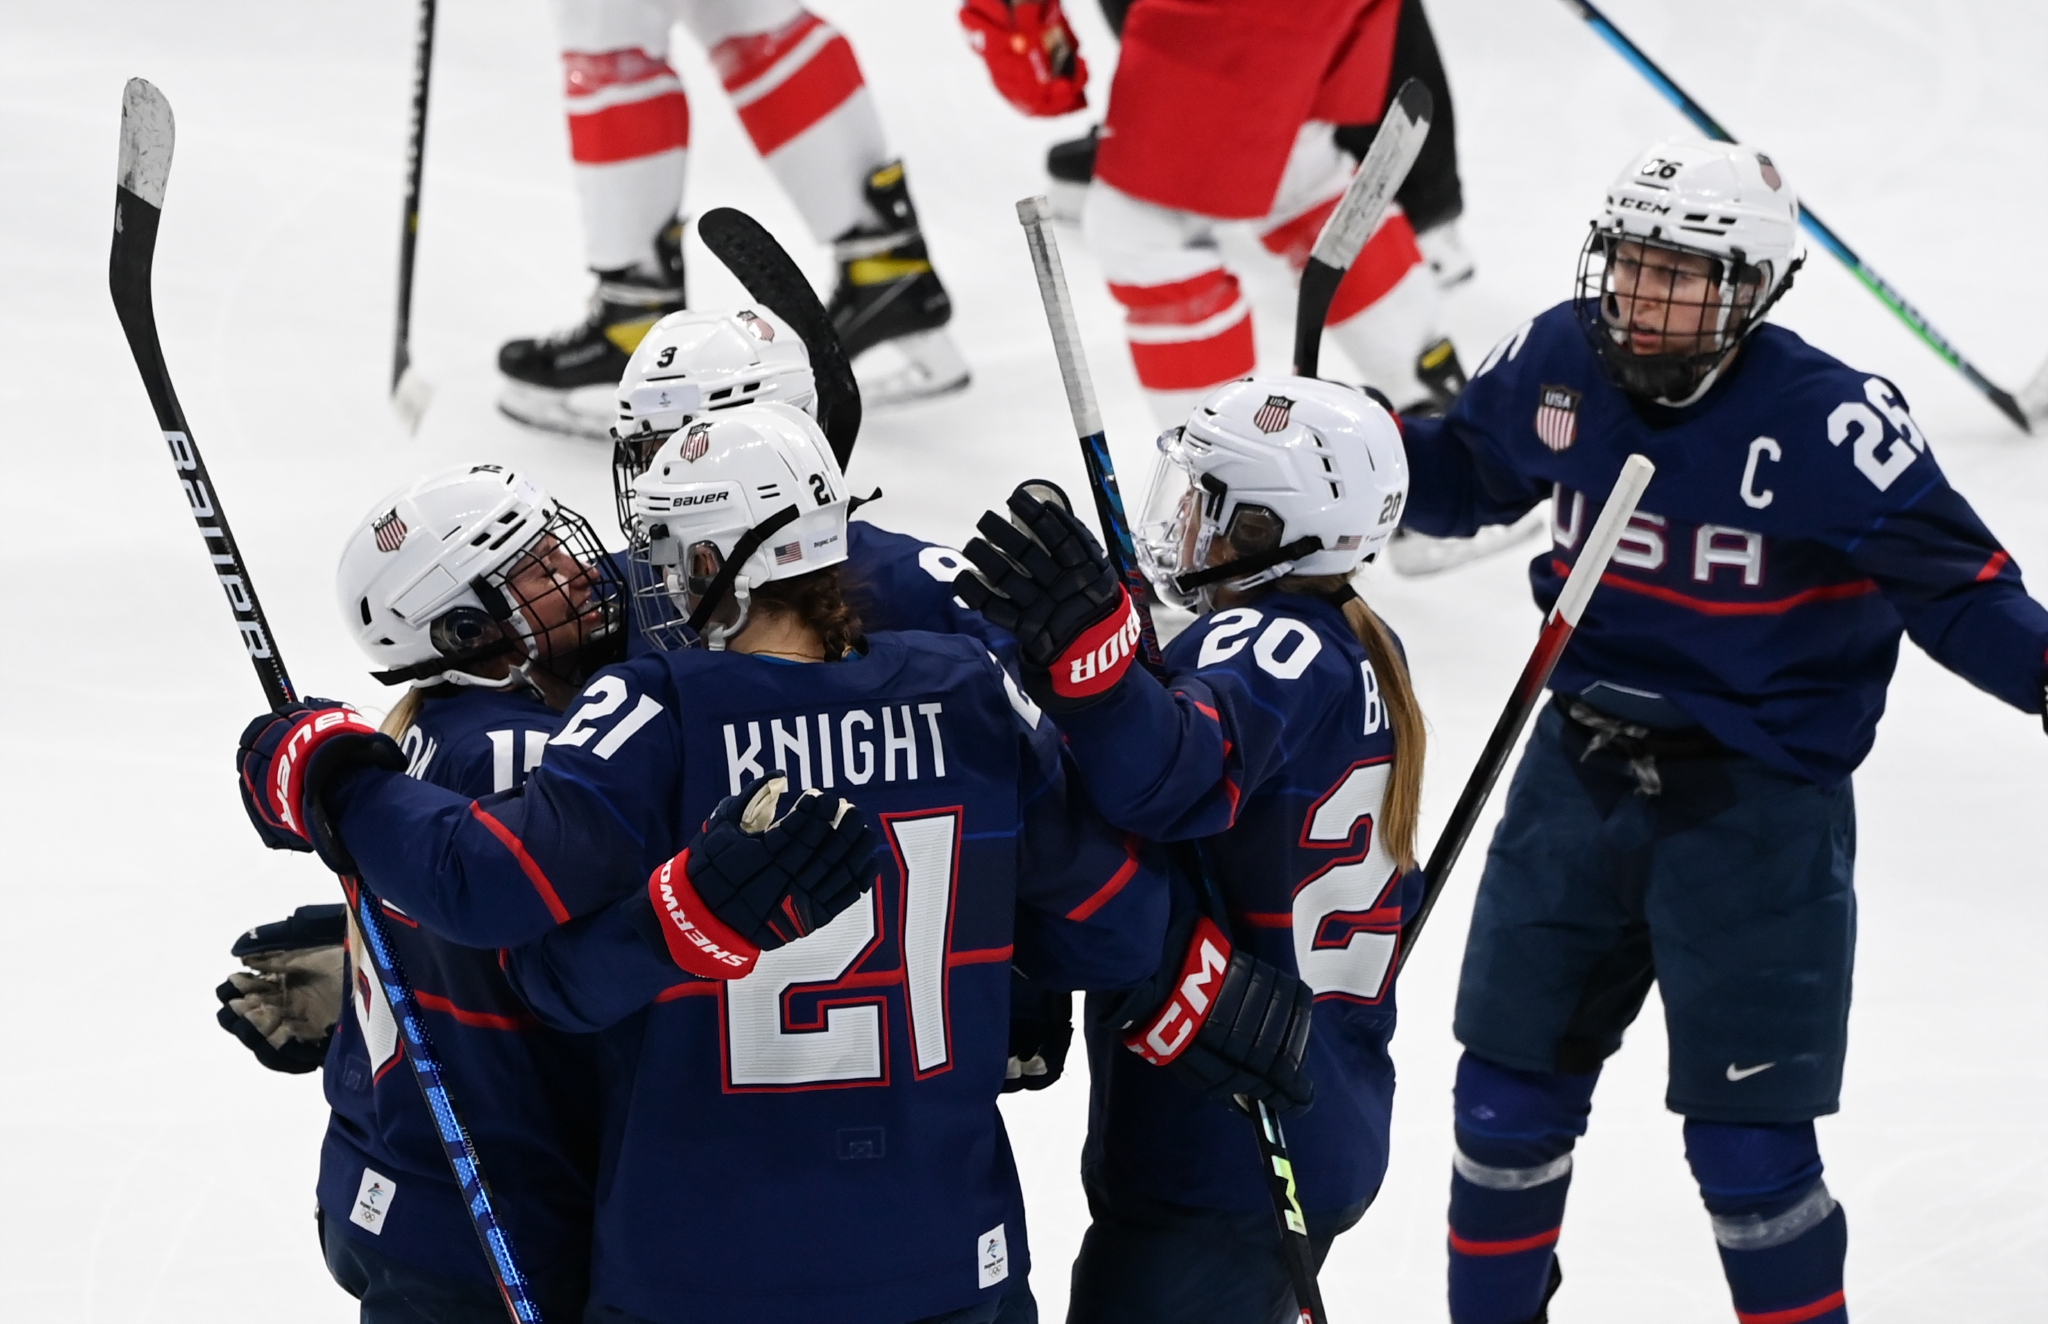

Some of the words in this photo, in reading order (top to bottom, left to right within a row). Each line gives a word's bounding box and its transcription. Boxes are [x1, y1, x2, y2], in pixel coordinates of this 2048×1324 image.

[1619, 196, 1672, 216] CCM
[1268, 397, 1290, 408] USA
[1544, 390, 1573, 410] USA
[1826, 376, 1925, 493] 26
[672, 491, 729, 507] BAUER
[1377, 490, 1403, 525] 20
[1739, 435, 1782, 509] C
[1551, 481, 1763, 586] USA
[1070, 593, 1141, 684] RIOR
[1197, 607, 1323, 681] 20
[547, 674, 664, 761] 21
[722, 702, 946, 797] KNIGHT
[659, 856, 749, 968] SHERWO
[720, 805, 963, 1093] 21
[1126, 937, 1228, 1065] CM
